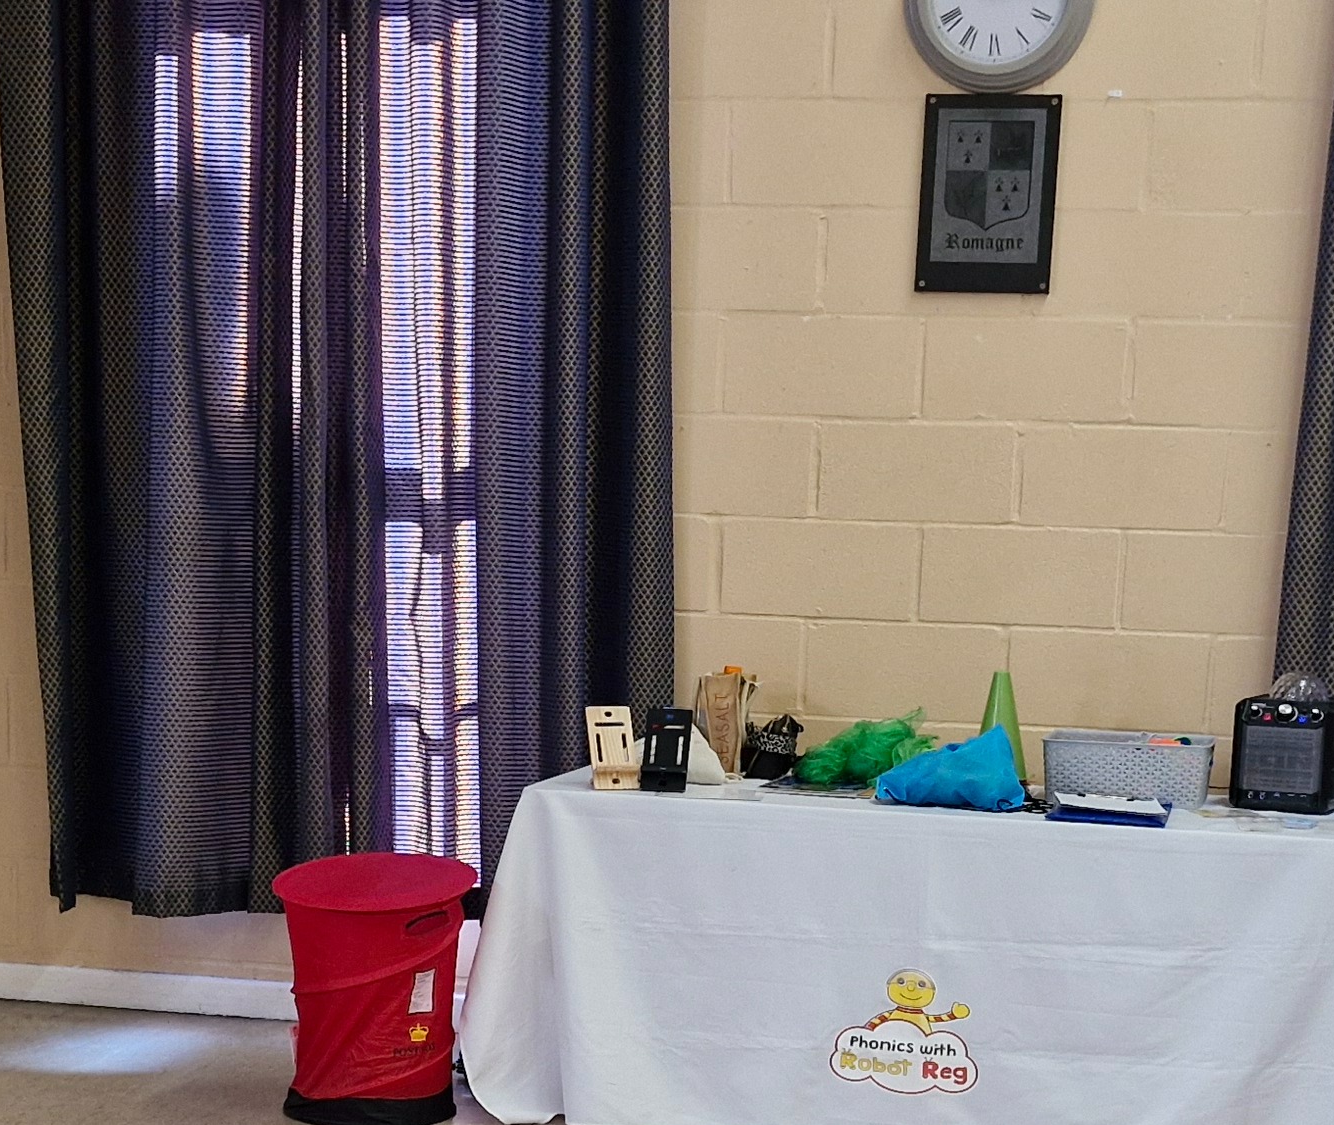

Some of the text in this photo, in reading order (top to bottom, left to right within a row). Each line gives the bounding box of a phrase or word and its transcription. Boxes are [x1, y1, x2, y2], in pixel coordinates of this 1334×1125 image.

[850, 1035, 956, 1056] Phonics with
[840, 1051, 967, 1084] Robot Reg
